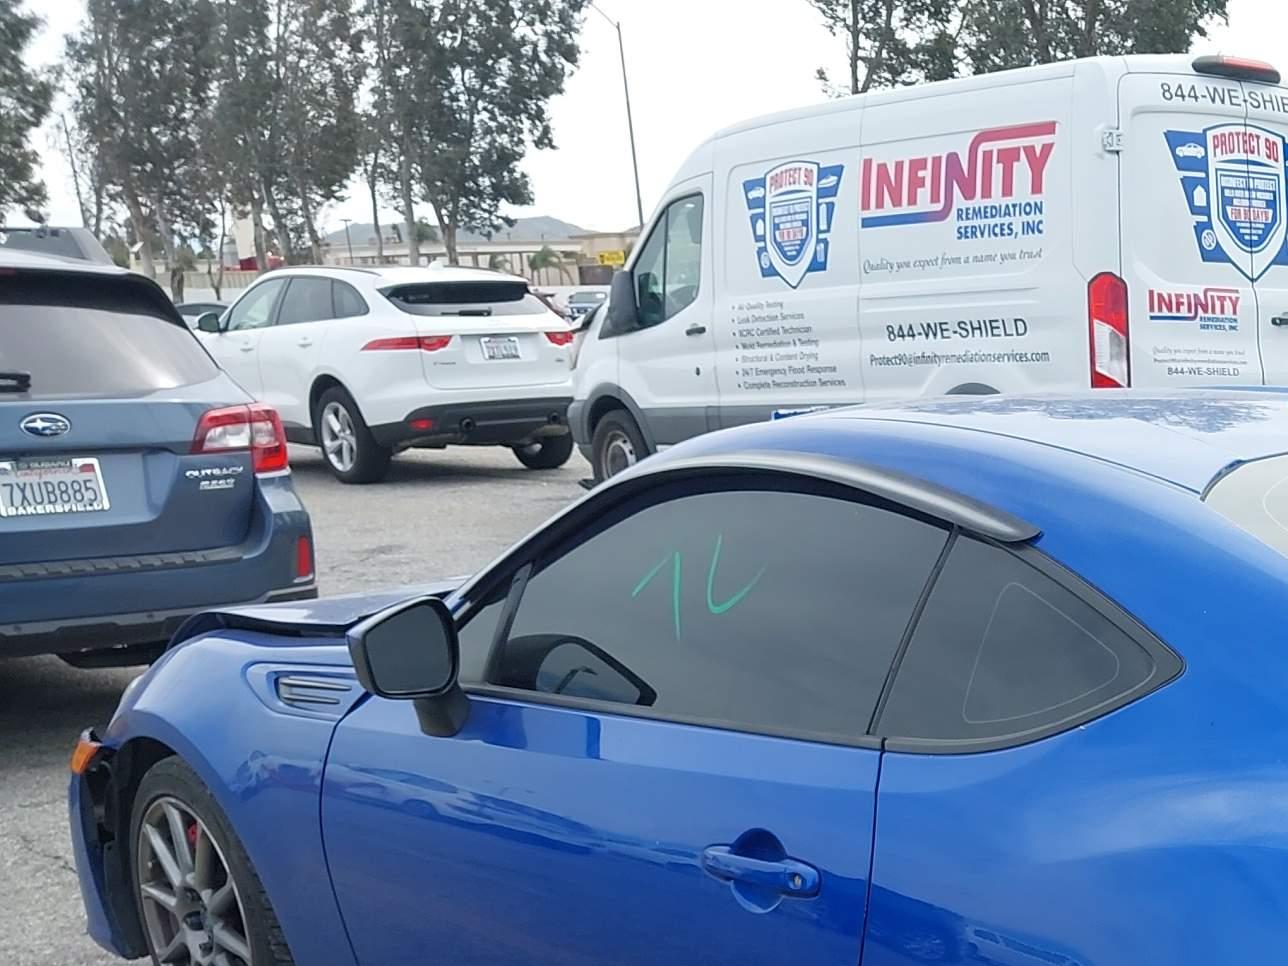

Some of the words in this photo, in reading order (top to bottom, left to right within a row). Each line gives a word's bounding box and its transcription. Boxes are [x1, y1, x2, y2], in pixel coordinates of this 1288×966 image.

[1212, 131, 1262, 158] PROTECT
[1264, 137, 1280, 163] 90
[860, 136, 1056, 217] INFINITY
[956, 201, 1044, 222] REMEDIATION
[956, 222, 1019, 241] SERVICES,
[1021, 219, 1044, 236] INC
[863, 256, 894, 274] Quality
[895, 259, 911, 272] you
[912, 255, 939, 271] expect
[939, 252, 962, 270] from
[972, 252, 998, 263] name
[999, 251, 1017, 265] you
[1018, 248, 1043, 260] trust
[1148, 288, 1240, 317] INFINITY
[886, 317, 1028, 342] 844-WE-SHIELD
[1167, 366, 1240, 377] 844-WE-SHIELD
[1, 479, 98, 507] 7XUB885
